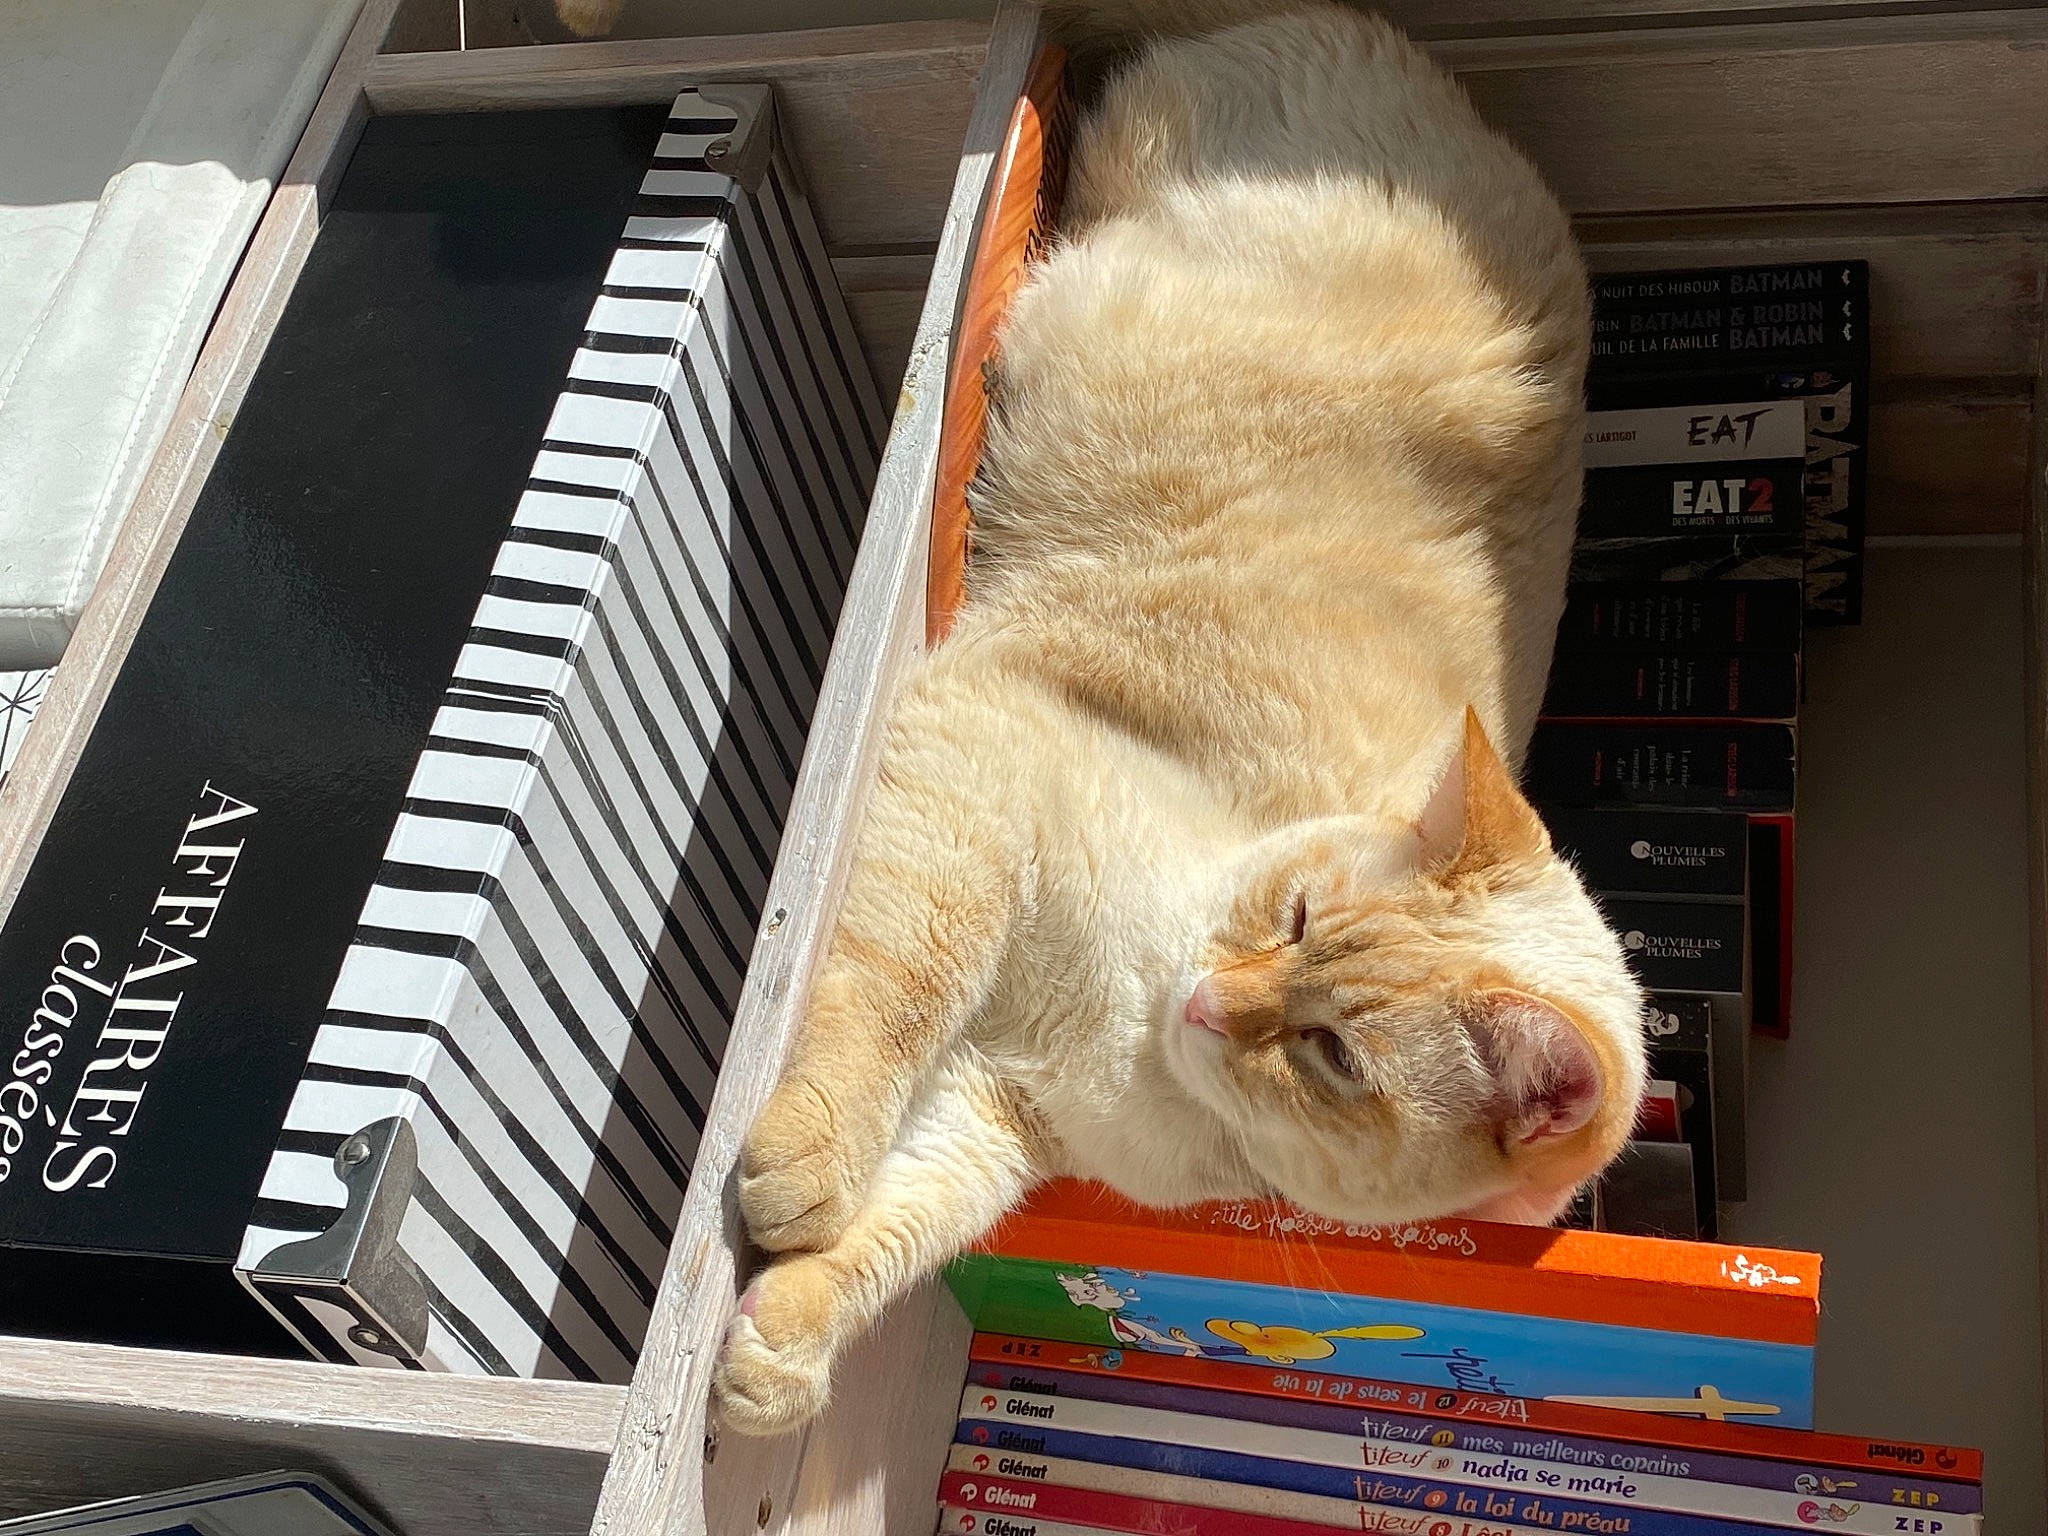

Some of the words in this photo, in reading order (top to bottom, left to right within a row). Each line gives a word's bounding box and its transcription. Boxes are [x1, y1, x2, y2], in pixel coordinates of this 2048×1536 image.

[1602, 285, 1632, 298] NUIT
[1640, 283, 1663, 296] DES
[1668, 279, 1720, 294] HIBOUX
[1730, 270, 1822, 294] BATMAN
[1630, 309, 1720, 334] BATMAN
[1753, 301, 1823, 324] ROBIN
[1620, 340, 1636, 354] DE
[1641, 338, 1658, 352] LA
[1664, 334, 1720, 350] FAMILLE
[1730, 324, 1823, 350] BATMAN
[1688, 409, 1774, 449] EAT
[1652, 856, 1707, 867] PLUMES
[1645, 949, 1702, 959] PLUMES
[42, 779, 258, 1191] AFFAIRES
[1391, 1224, 1477, 1256] saisons
[1010, 1376, 1058, 1393] Glénat
[1272, 1374, 1300, 1391] vie
[1305, 1379, 1324, 1397] la
[1329, 1381, 1354, 1400] de
[1358, 1385, 1401, 1402] sens
[1407, 1391, 1428, 1410] le
[1006, 1399, 1055, 1418] Glénat
[1456, 1398, 1530, 1423] titeuf
[998, 1430, 1046, 1451] Glénat
[1360, 1416, 1433, 1442] titeuf
[1463, 1436, 1503, 1453] mes
[1512, 1438, 1605, 1465] meilleurs
[1610, 1453, 1690, 1477] copains
[1867, 1443, 1925, 1465] Glénat
[999, 1458, 1048, 1479] Glénat
[1360, 1441, 1432, 1469] titeuf
[1463, 1459, 1528, 1482] nadia
[1535, 1470, 1560, 1486] se
[1567, 1475, 1637, 1497] marie
[985, 1486, 1036, 1509] Glénat
[1353, 1475, 1426, 1504] titeuf
[1456, 1491, 1477, 1512] la
[1484, 1492, 1515, 1517] loi
[1522, 1501, 1554, 1526] du
[1561, 1510, 1631, 1534] préau
[1892, 1488, 1940, 1507] ZEP
[985, 1518, 1036, 1536] Glénat
[1358, 1506, 1431, 1534] titeuf
[1895, 1516, 1943, 1534] ZEP
